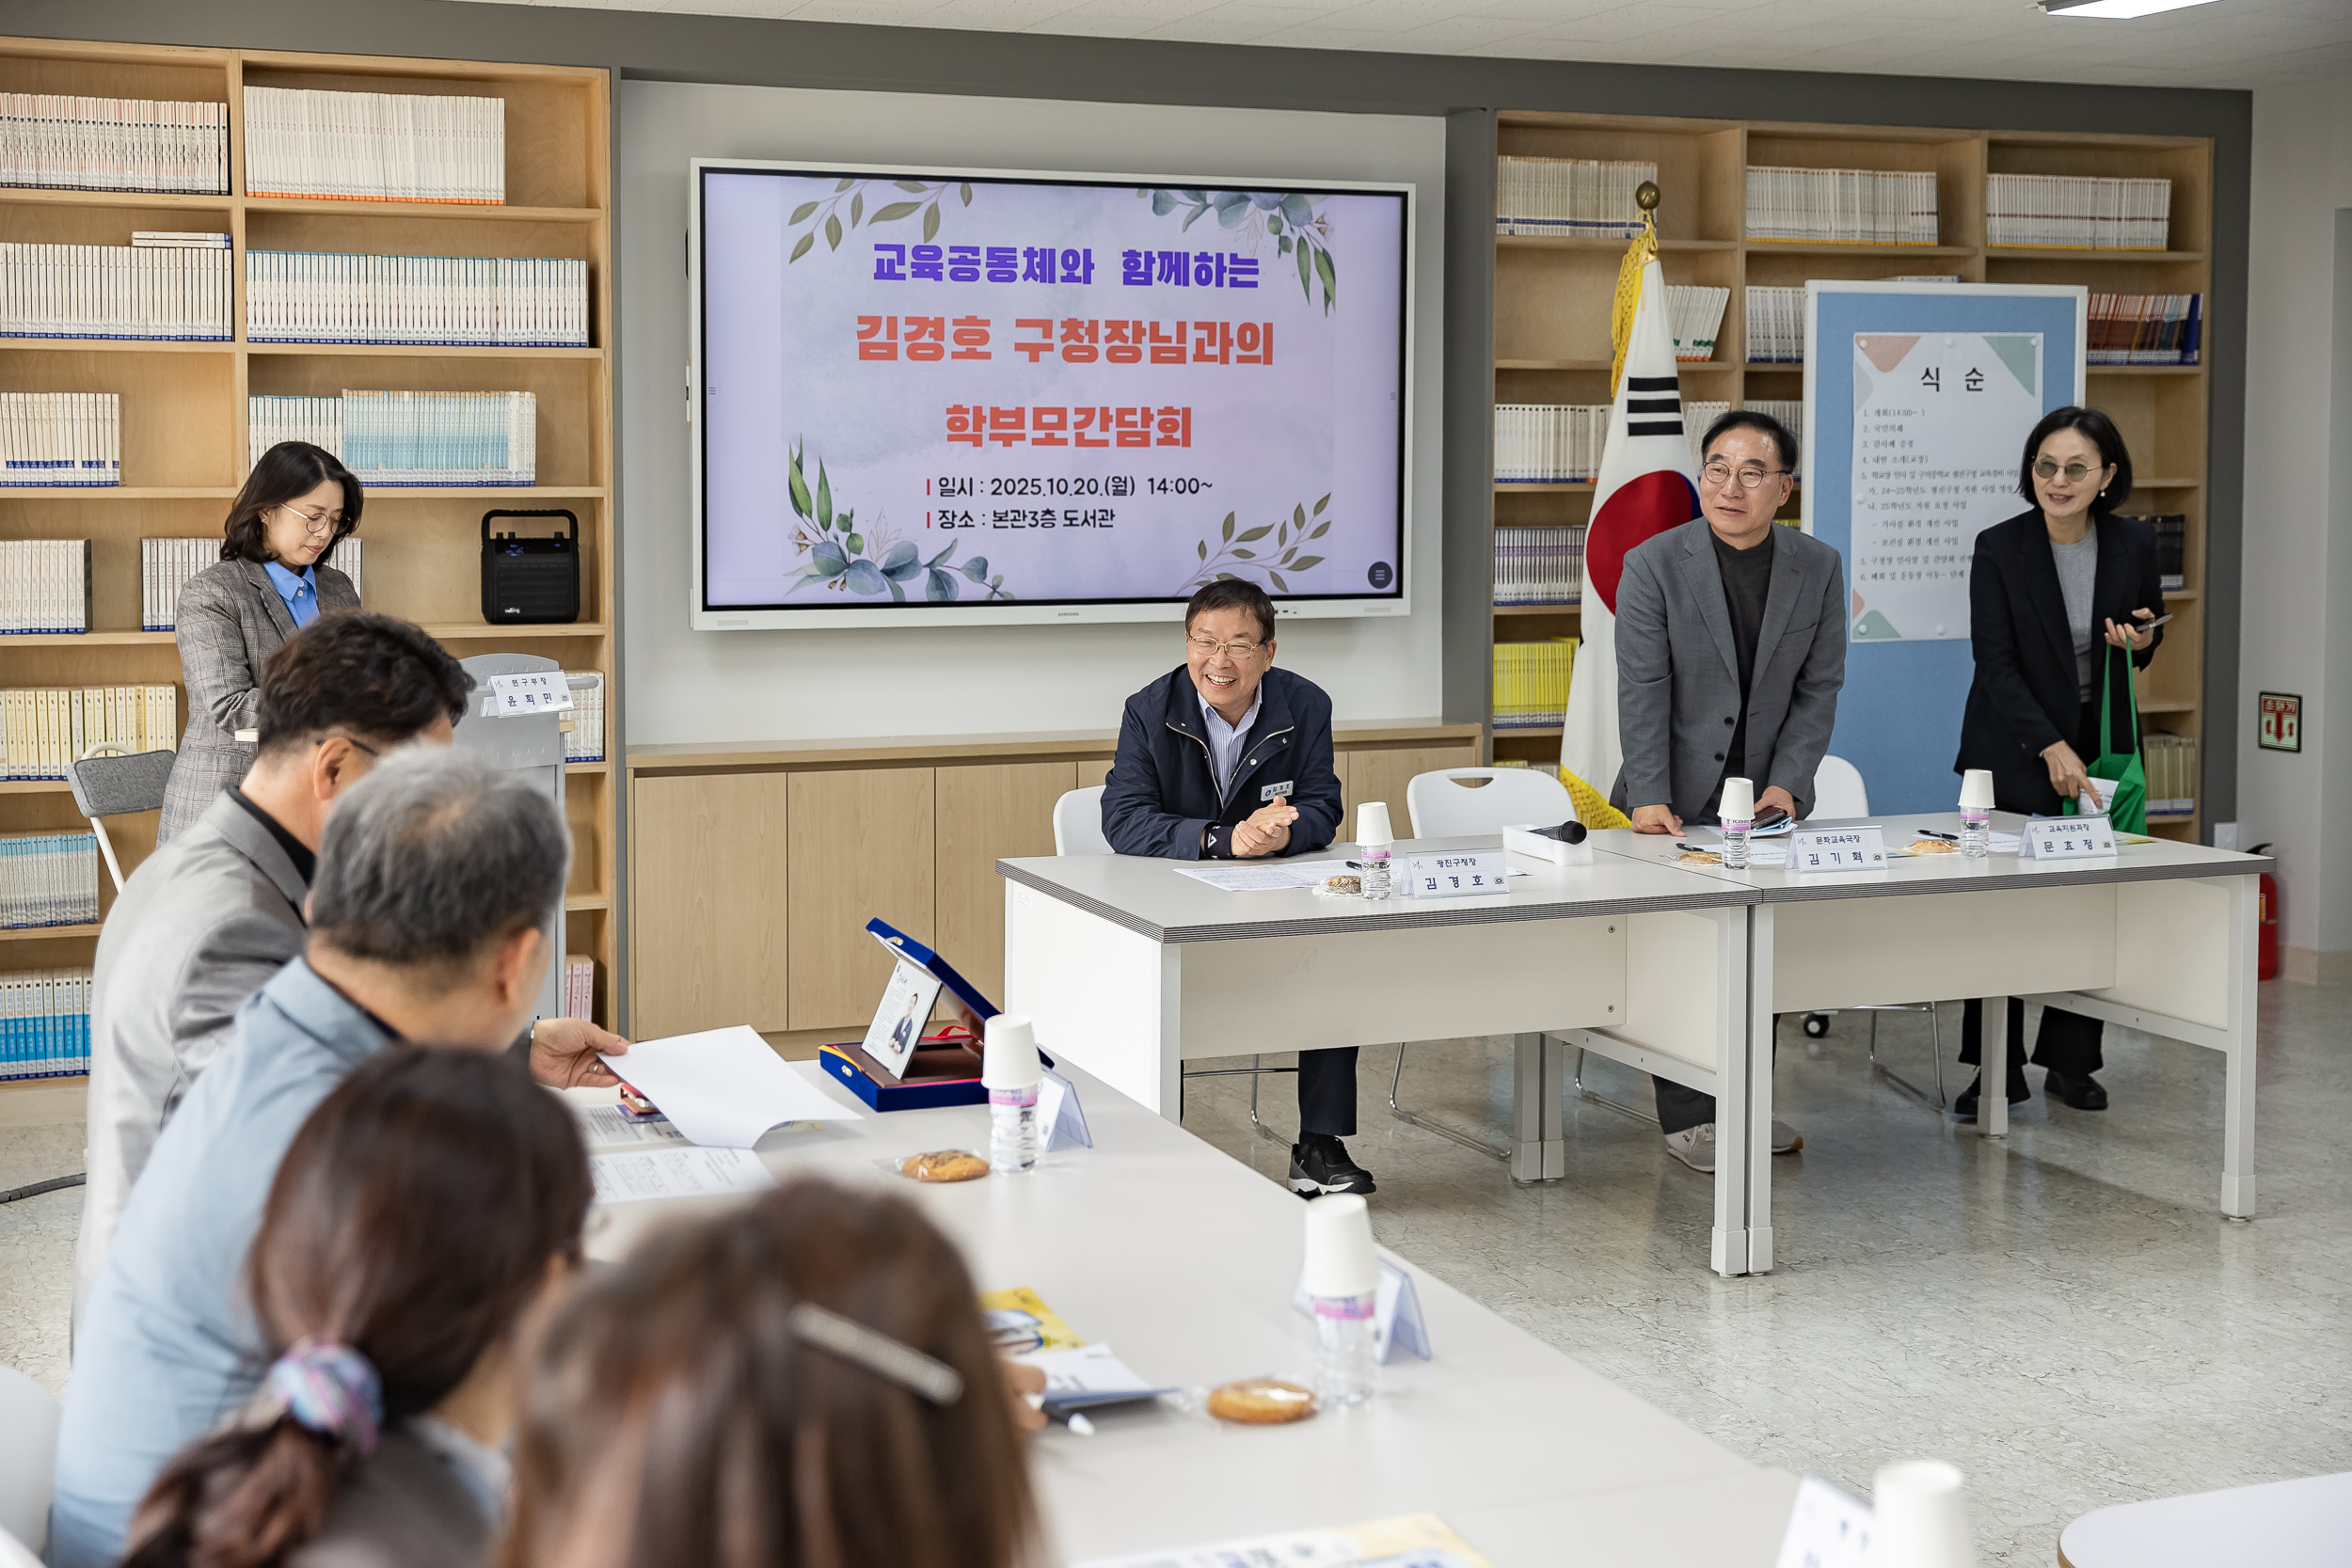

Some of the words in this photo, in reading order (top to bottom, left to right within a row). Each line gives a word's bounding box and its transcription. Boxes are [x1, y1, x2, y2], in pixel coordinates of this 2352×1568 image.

[873, 243, 1095, 285] 교육공동체와
[1121, 248, 1260, 289] 함께하는
[856, 314, 993, 362] 김경호
[1013, 317, 1274, 366] 구청장님과의
[1920, 367, 1940, 392] 식
[1964, 367, 1984, 392] 순
[946, 404, 1192, 448] 학부모간담회
[939, 476, 974, 498] 일시
[991, 475, 1136, 498] 2025.10.20.(월)
[1147, 477, 1214, 495] 14:00~
[939, 510, 976, 530] 장소
[992, 508, 1057, 530] 본관3층
[1062, 508, 1116, 529] 도서관
[512, 677, 548, 688] 연구부장
[2048, 823, 2090, 833] 교육지원과장
[1815, 834, 1861, 845] 문화교육국장
[1436, 857, 1477, 868] 광진구청장
